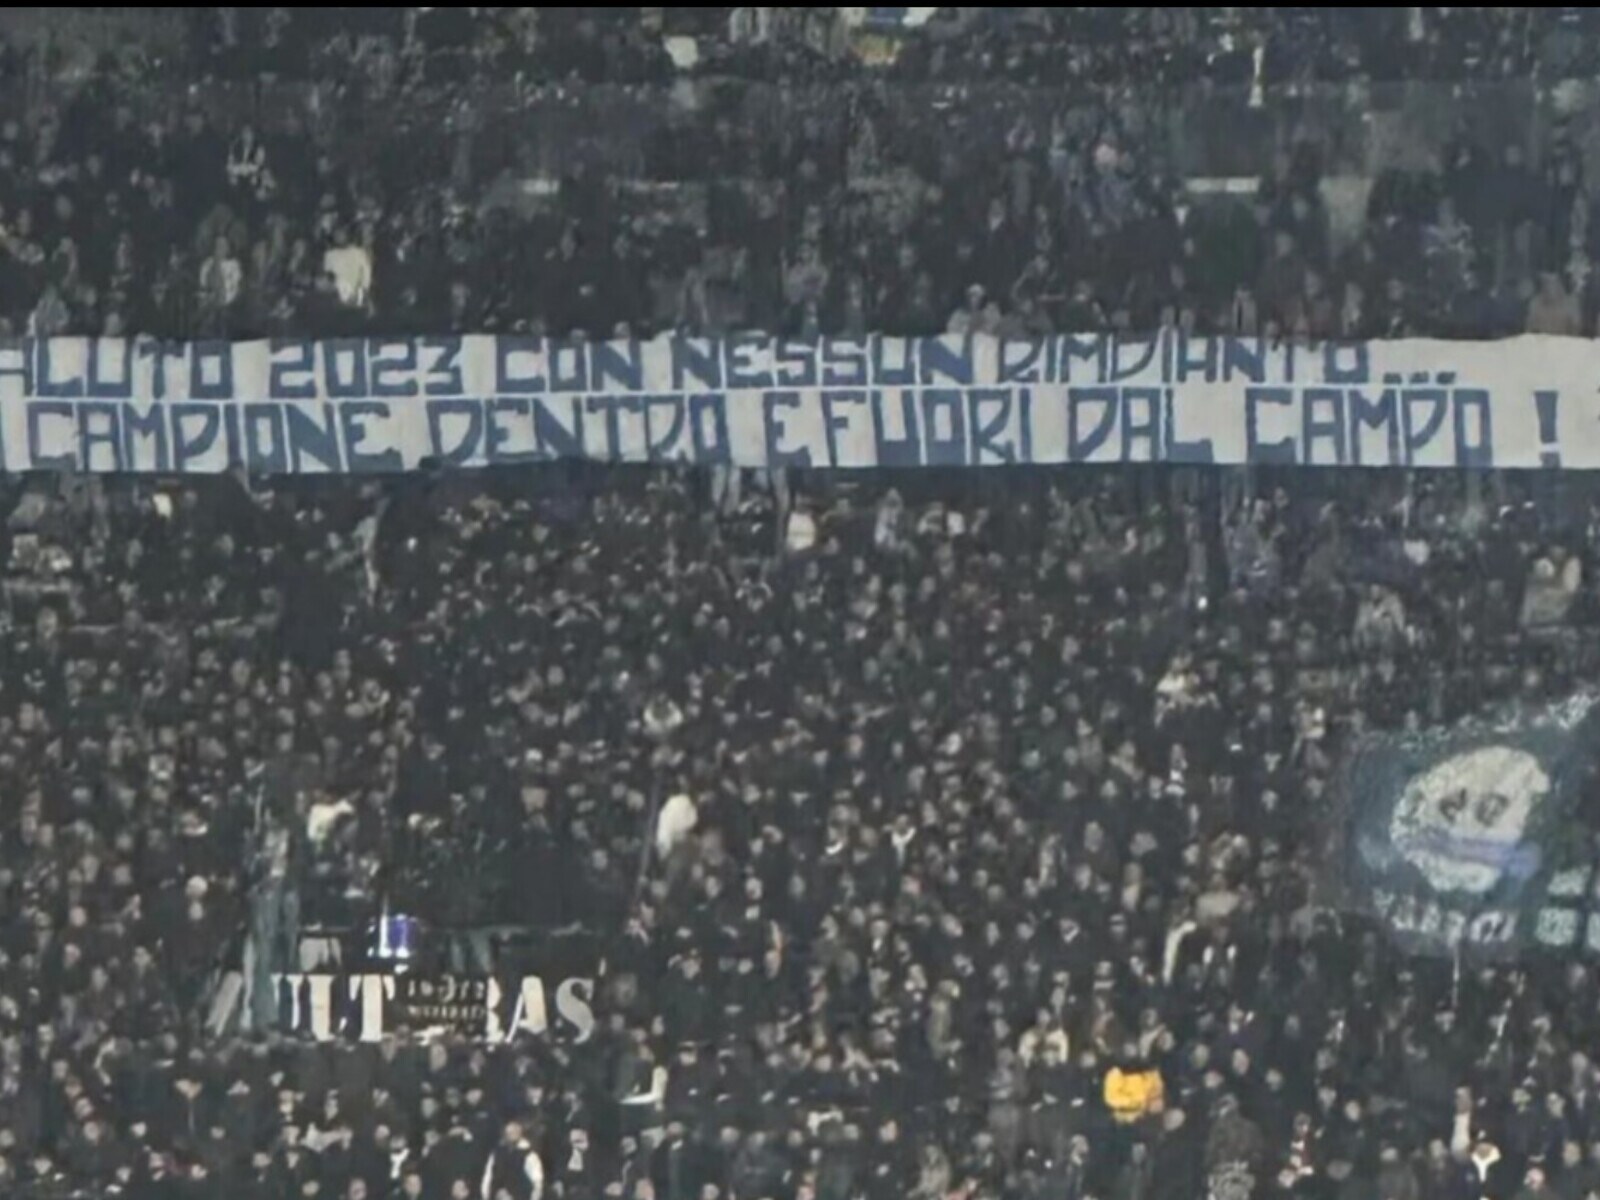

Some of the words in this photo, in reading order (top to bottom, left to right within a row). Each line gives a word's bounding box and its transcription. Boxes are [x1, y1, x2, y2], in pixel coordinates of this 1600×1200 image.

[270, 338, 463, 398] 2023
[496, 335, 644, 393] CON
[672, 333, 973, 391] NESSUN
[27, 402, 402, 473] CAMPIONE
[763, 392, 813, 467] E
[820, 387, 1032, 467] FUORI
[1067, 387, 1213, 464] DAL
[1244, 388, 1493, 467] CAMPO
